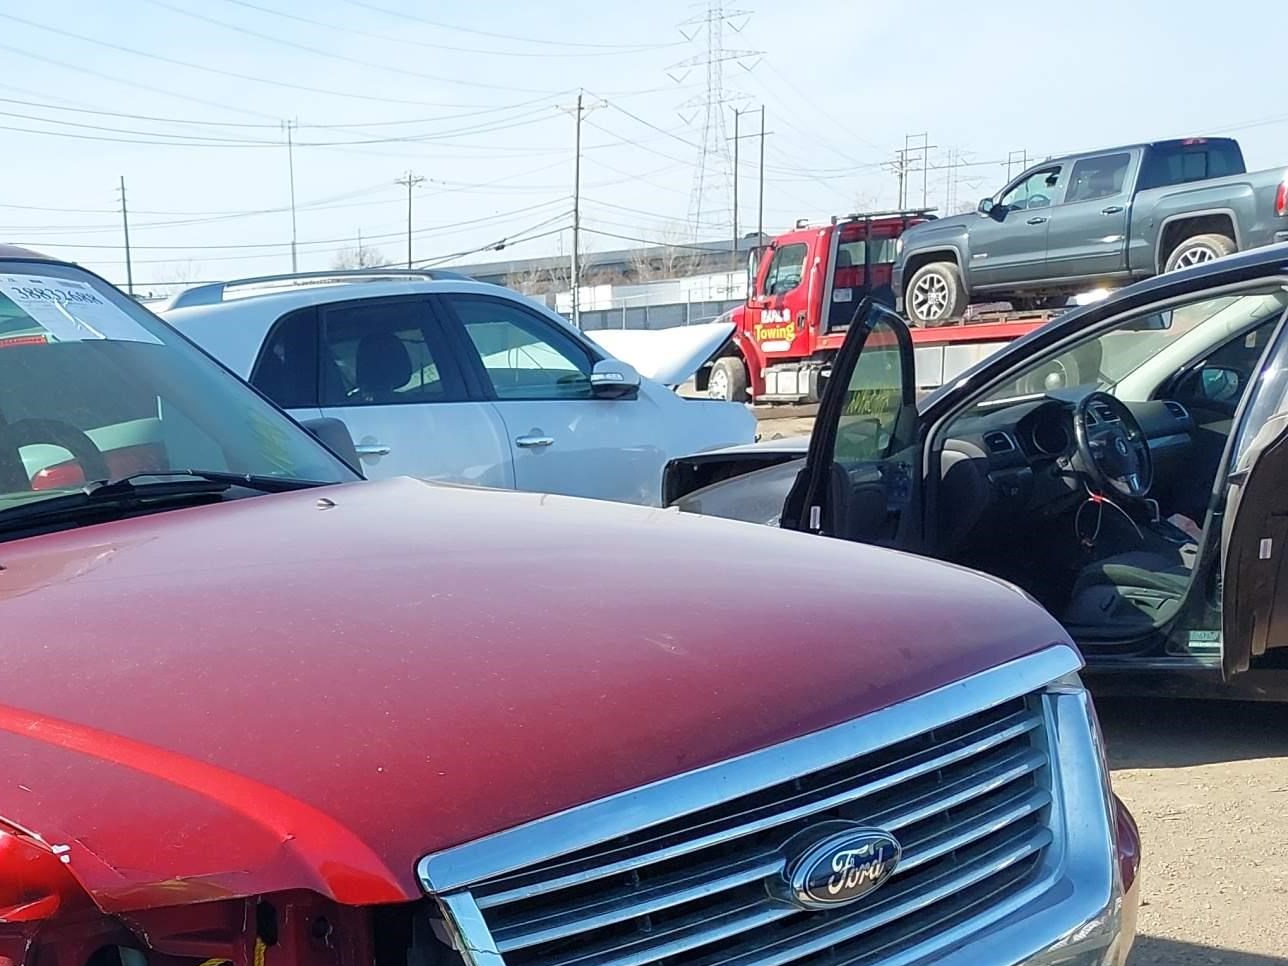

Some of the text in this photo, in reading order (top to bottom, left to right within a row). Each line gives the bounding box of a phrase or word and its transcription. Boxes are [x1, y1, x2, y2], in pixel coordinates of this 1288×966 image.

[12, 287, 104, 305] 38832688
[754, 322, 796, 342] Towing
[828, 844, 885, 895] Ford
